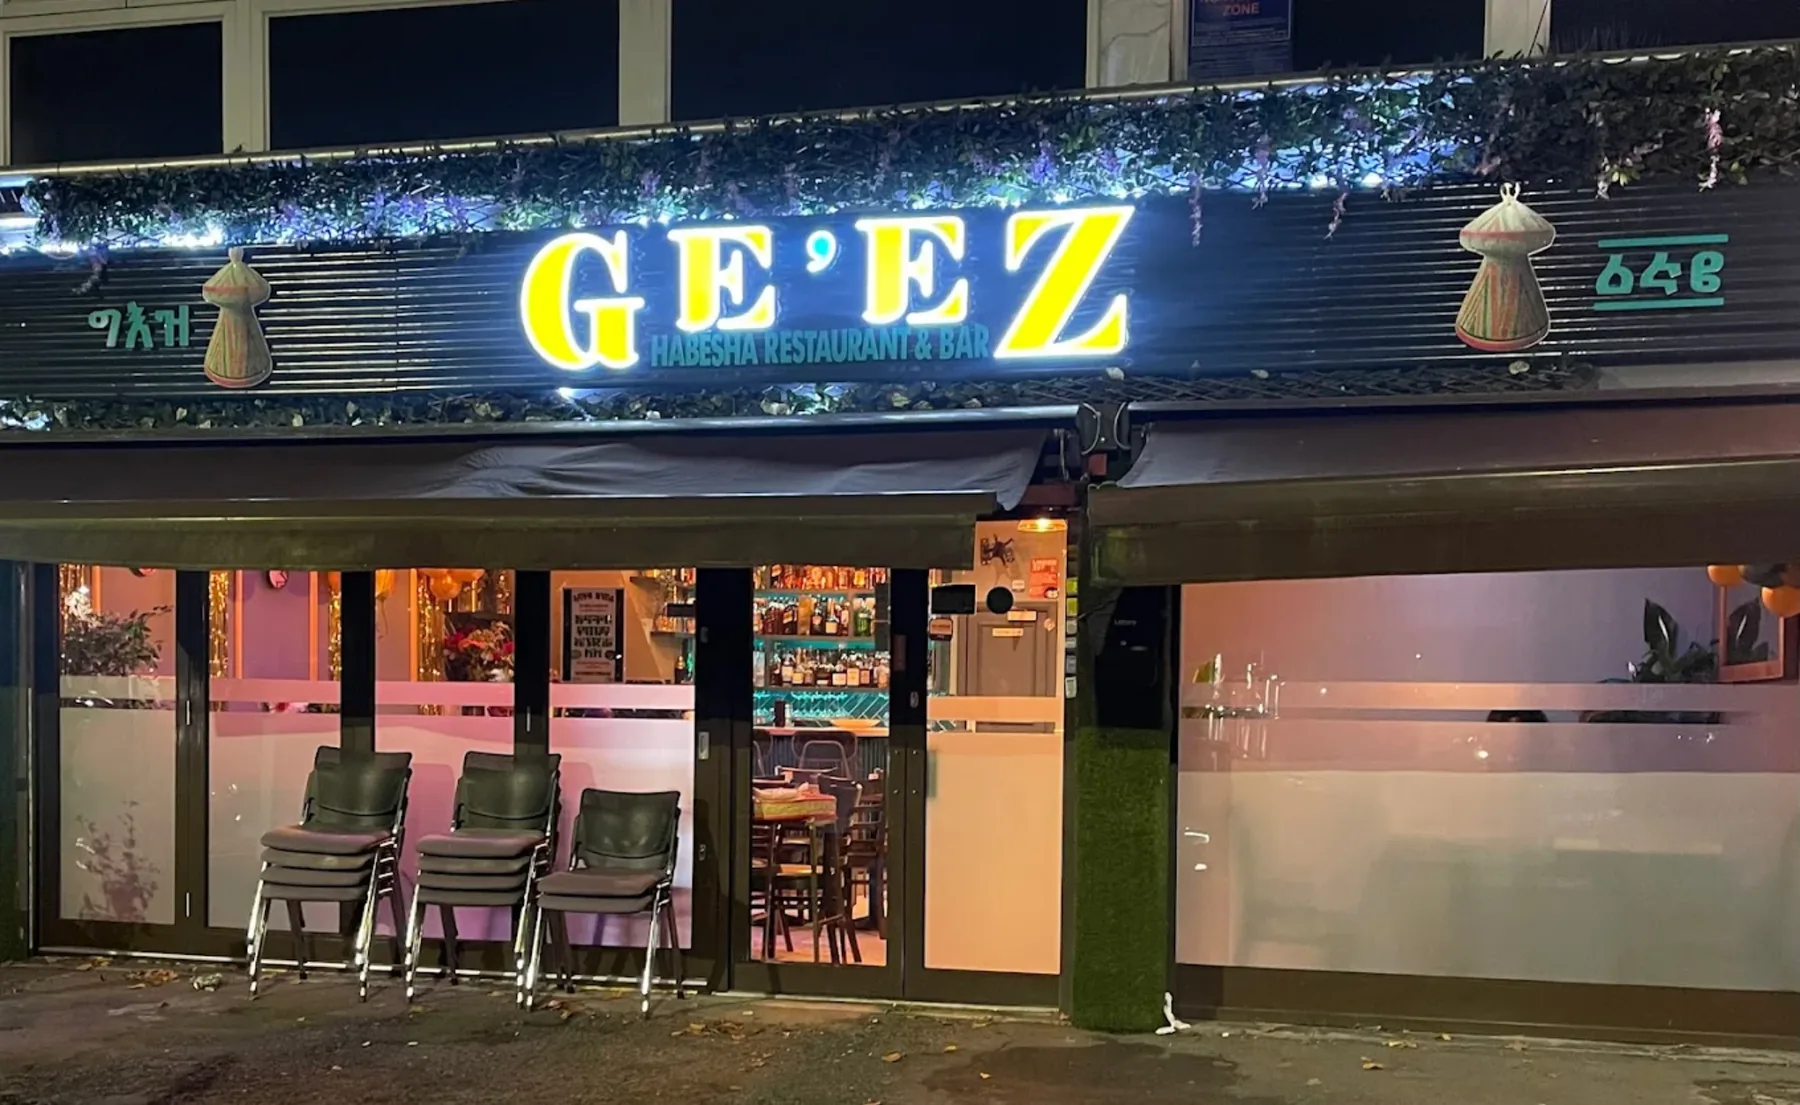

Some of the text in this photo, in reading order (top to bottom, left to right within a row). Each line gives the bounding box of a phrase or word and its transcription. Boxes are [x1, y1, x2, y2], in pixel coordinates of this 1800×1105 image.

[1222, 3, 1260, 16] ZONE
[88, 301, 190, 349] ግእዝ
[651, 325, 990, 368] HABESHA RESTAURANT & BAR
